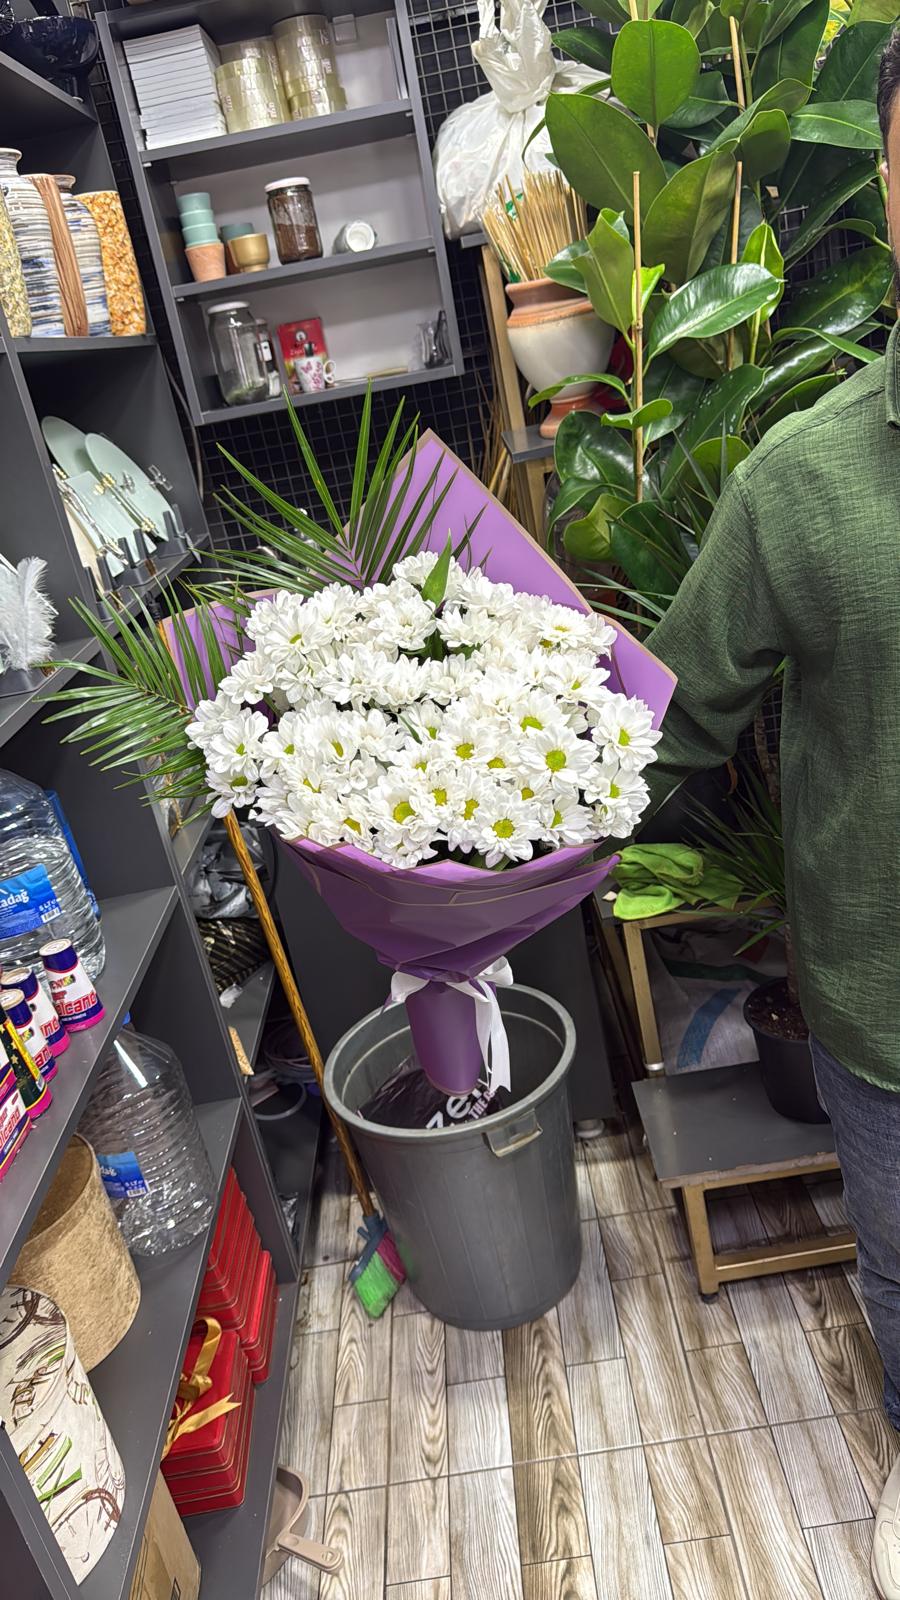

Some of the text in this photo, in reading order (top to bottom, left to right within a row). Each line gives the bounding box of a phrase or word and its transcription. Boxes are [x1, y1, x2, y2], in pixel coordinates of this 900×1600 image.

[0, 889, 29, 908] adağ
[55, 990, 98, 1016] olcano
[468, 1097, 489, 1120] THE
